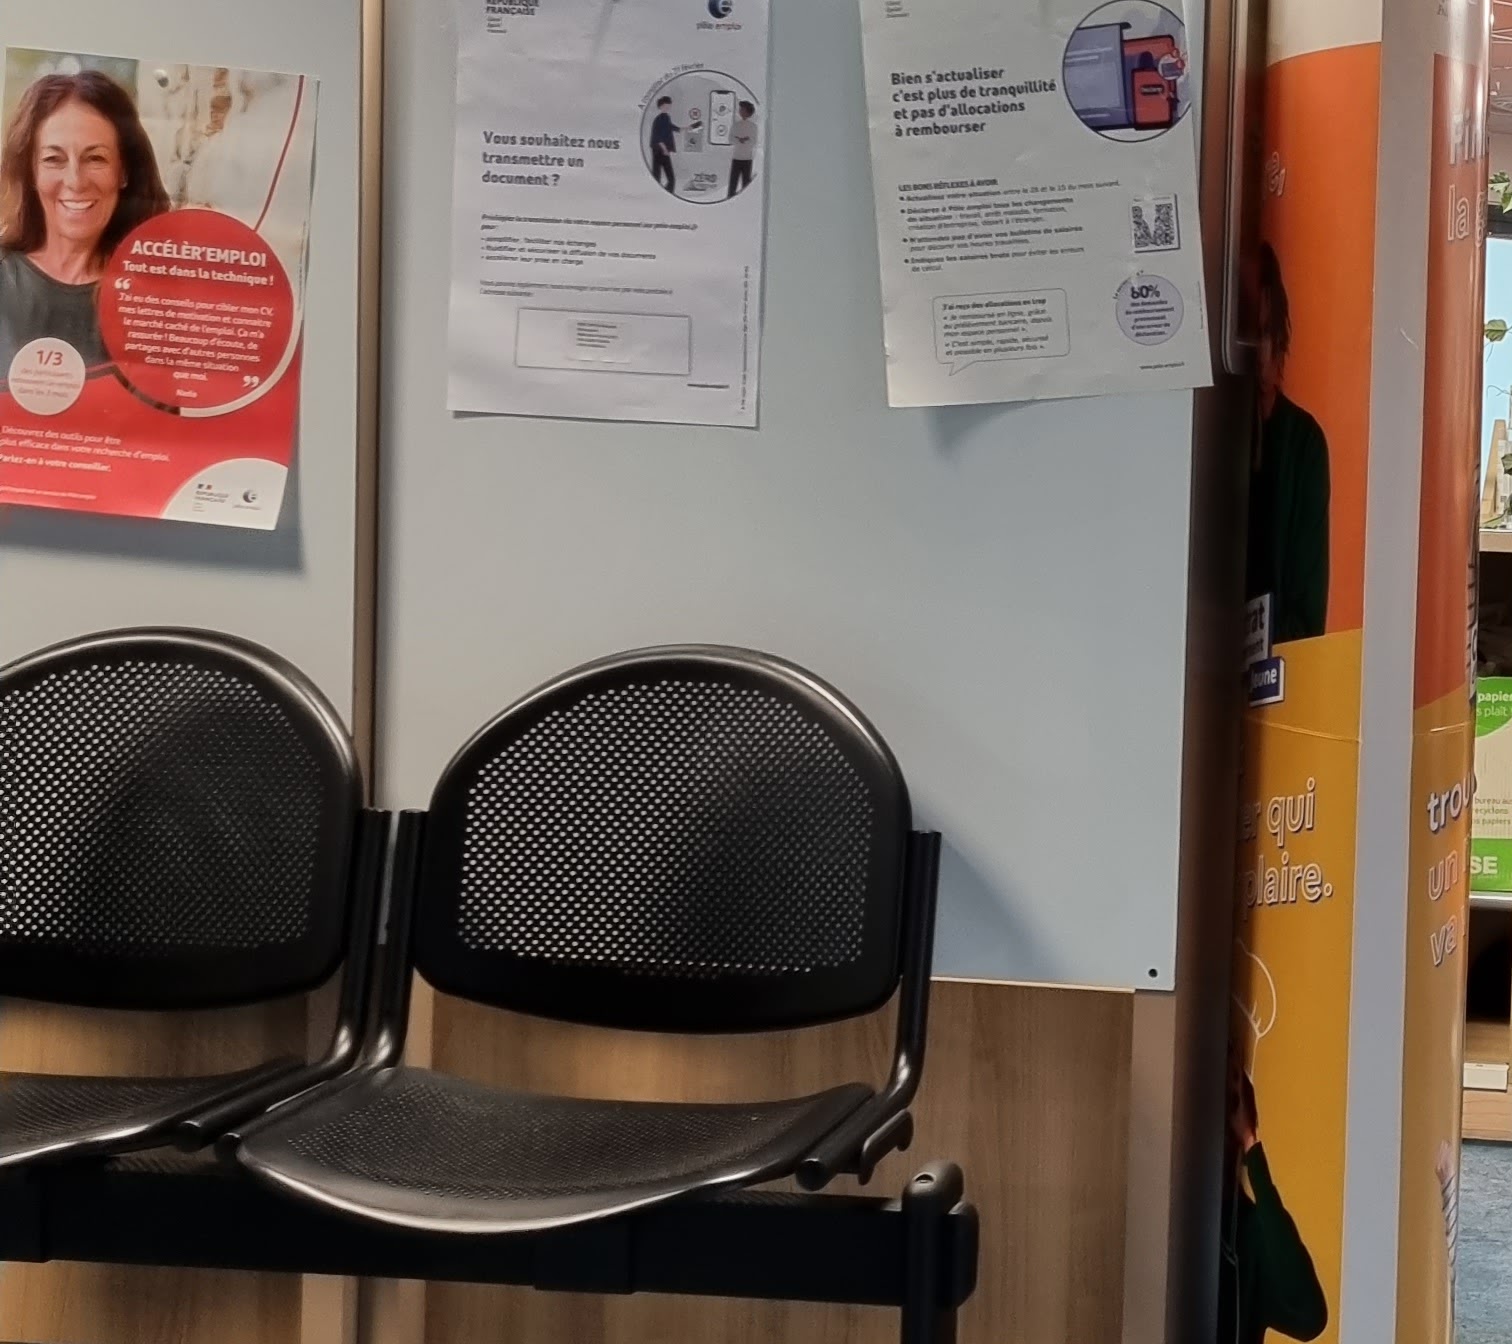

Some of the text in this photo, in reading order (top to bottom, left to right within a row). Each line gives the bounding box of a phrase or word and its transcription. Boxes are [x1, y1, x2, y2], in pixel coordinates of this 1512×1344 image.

[891, 67, 1005, 85] Bien s'actualiser
[892, 79, 1057, 104] c'est plus de tranquillité
[893, 100, 1025, 121] et pas d'allocations
[895, 121, 986, 137] à rembourser
[483, 131, 620, 150] Vous souhaitez nous
[482, 152, 584, 168] transmettre un
[481, 171, 561, 186] document ?
[1448, 184, 1469, 241] la
[131, 239, 266, 267] ACCÉLÈR'EMPLOI
[123, 260, 148, 273] Tout
[150, 264, 167, 275] est
[169, 264, 196, 278] dans
[198, 268, 209, 279] la
[212, 270, 268, 286] technique
[161, 297, 194, 308] conseils
[165, 309, 176, 318] de
[177, 310, 221, 323] motivation
[36, 350, 63, 367] 1/3
[2, 426, 44, 437] Découvrez
[45, 430, 59, 439] des
[1267, 776, 1316, 848] qui
[1428, 850, 1459, 901] un
[1430, 914, 1457, 967] va
